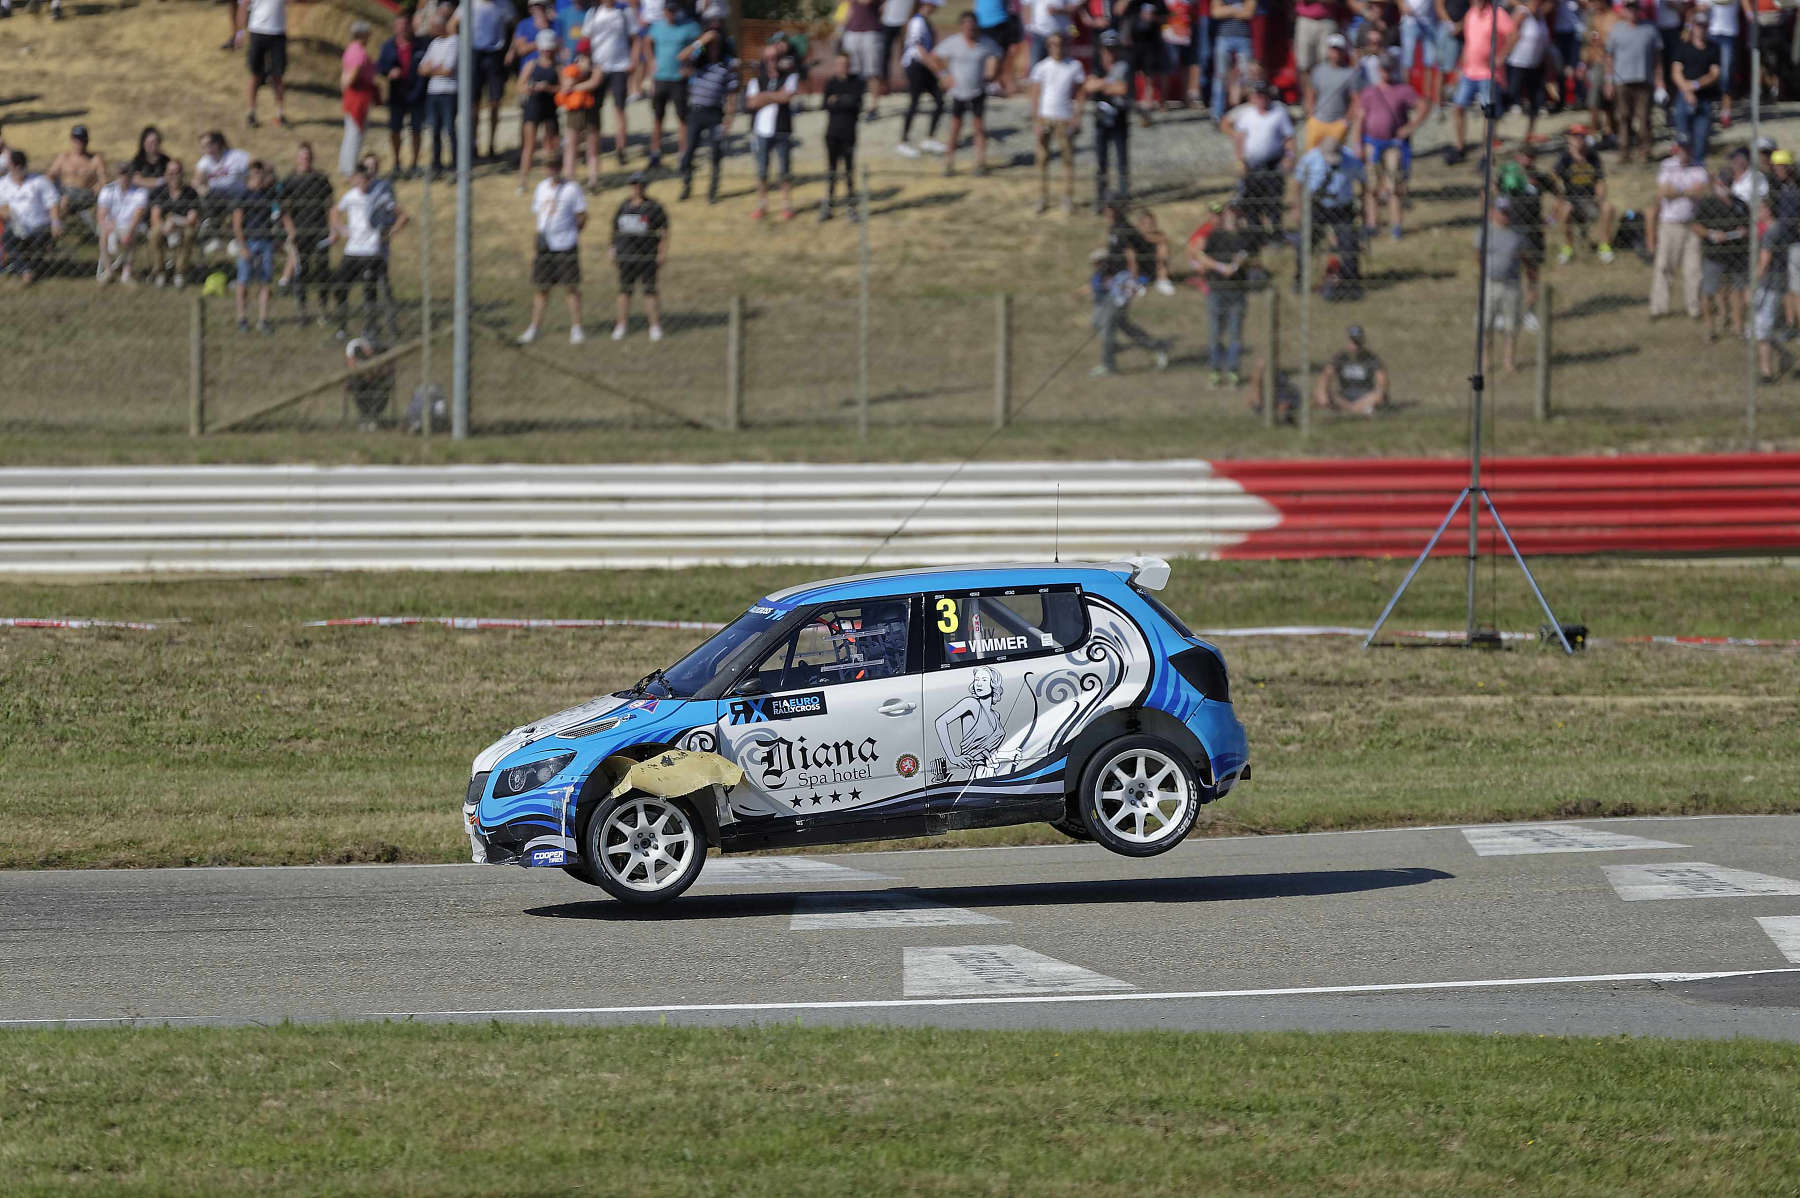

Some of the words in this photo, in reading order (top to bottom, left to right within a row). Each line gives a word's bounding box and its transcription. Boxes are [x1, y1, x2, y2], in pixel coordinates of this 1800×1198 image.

[935, 598, 959, 634] 3
[968, 636, 1028, 653] VIMMER
[773, 703, 821, 715] RALLYCROSS
[755, 735, 880, 790] Diana
[798, 772, 828, 790] Spa
[831, 764, 872, 783] hotel
[534, 850, 564, 860] COOPER
